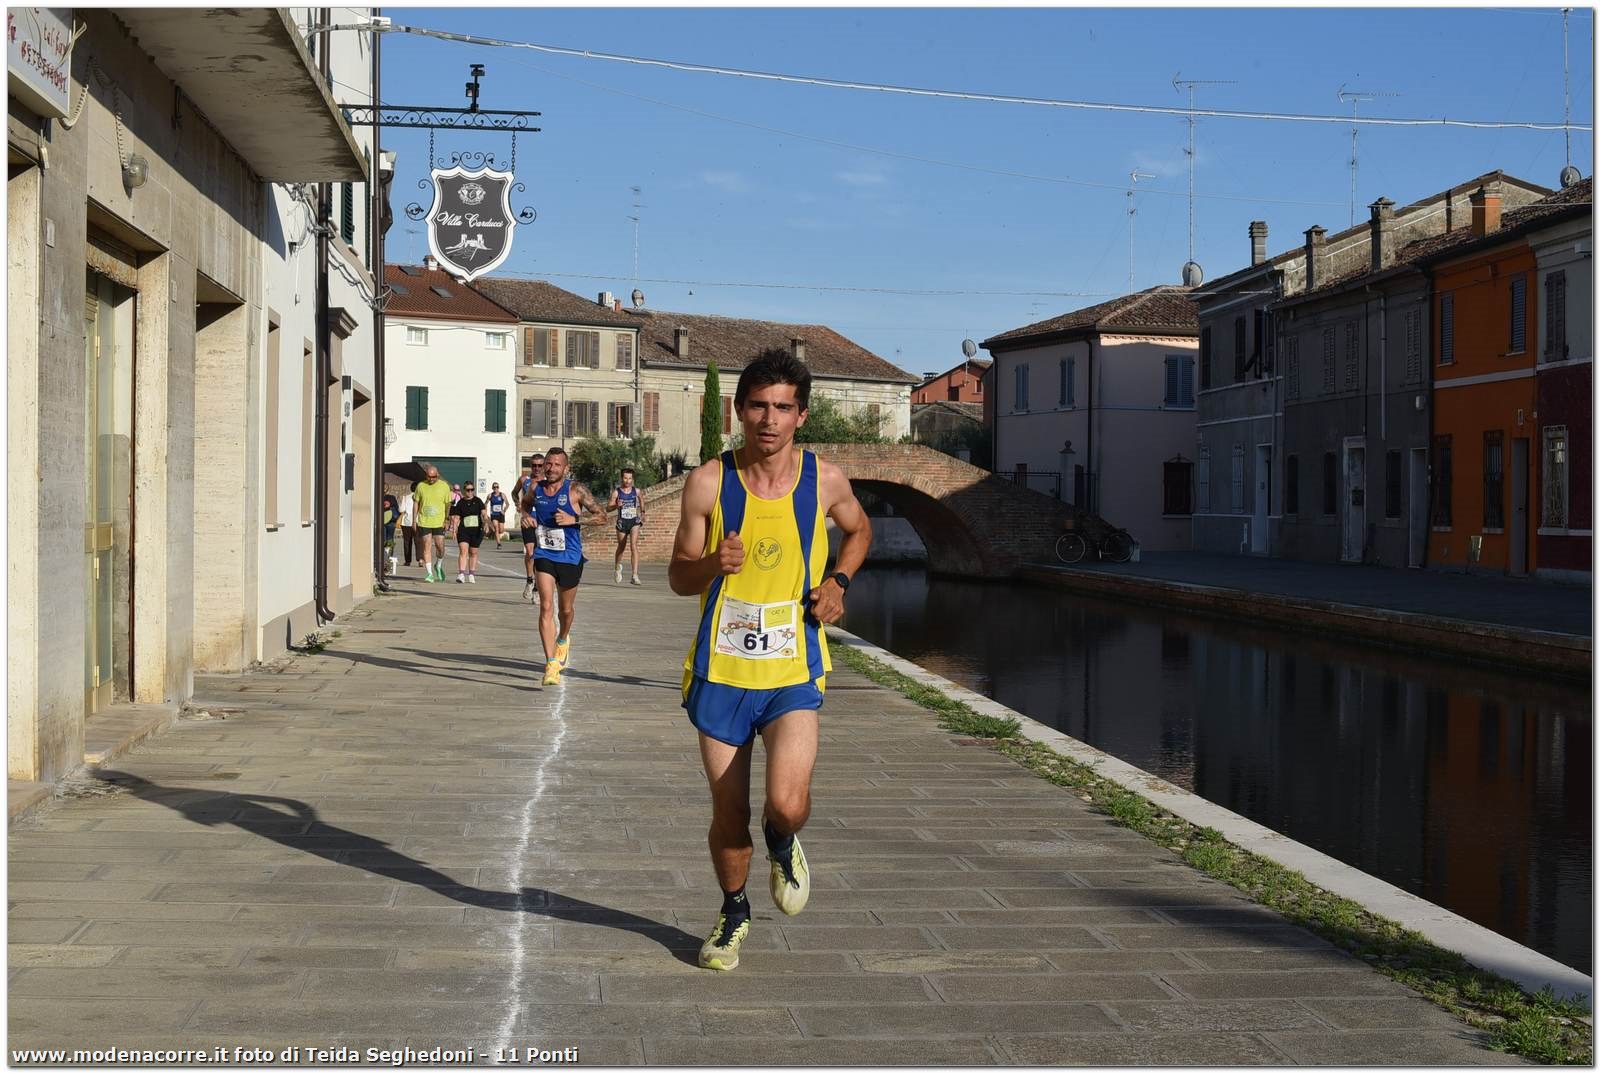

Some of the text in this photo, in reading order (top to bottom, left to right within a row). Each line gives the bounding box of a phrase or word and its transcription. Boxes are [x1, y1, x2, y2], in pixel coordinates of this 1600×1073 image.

[437, 211, 504, 228] Villa Carducci
[743, 633, 769, 651] 61
